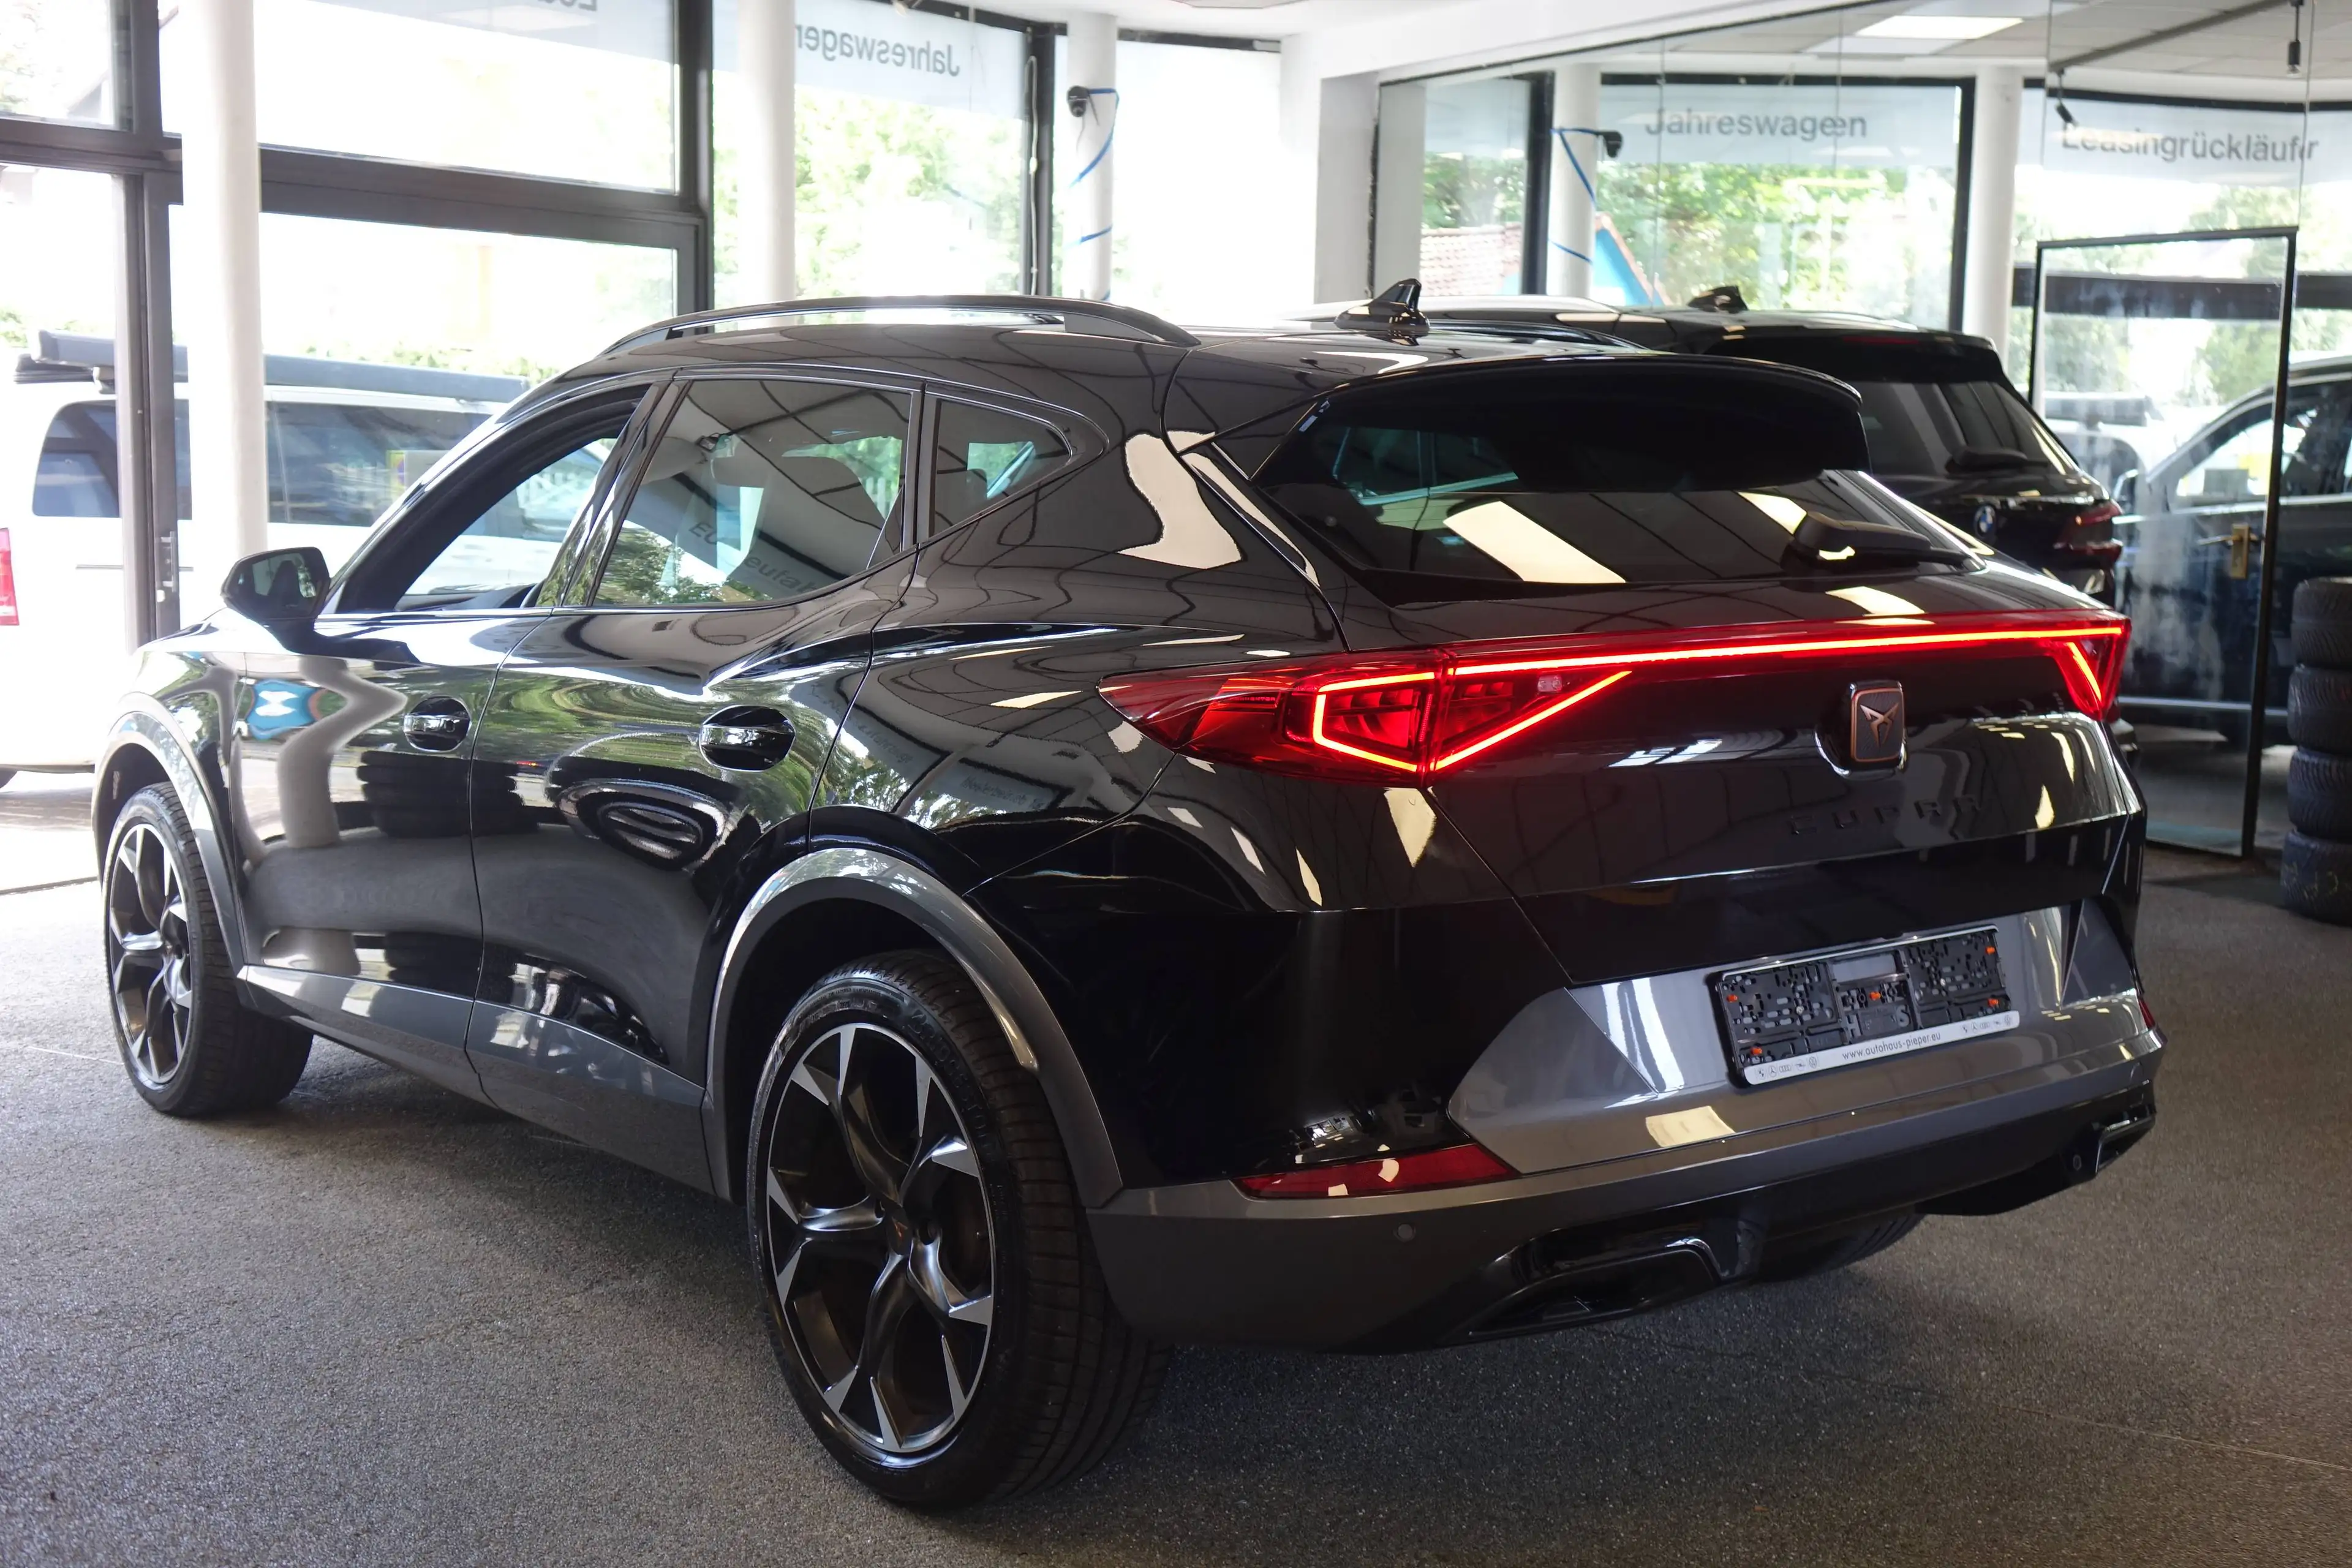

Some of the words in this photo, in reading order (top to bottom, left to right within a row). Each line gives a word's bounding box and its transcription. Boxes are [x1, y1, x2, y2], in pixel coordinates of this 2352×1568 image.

[1645, 107, 1868, 142] Jahreswagen
[1789, 796, 1981, 835] CUPRA
[1842, 1031, 1941, 1060] www.autohaus-pieper.eu
